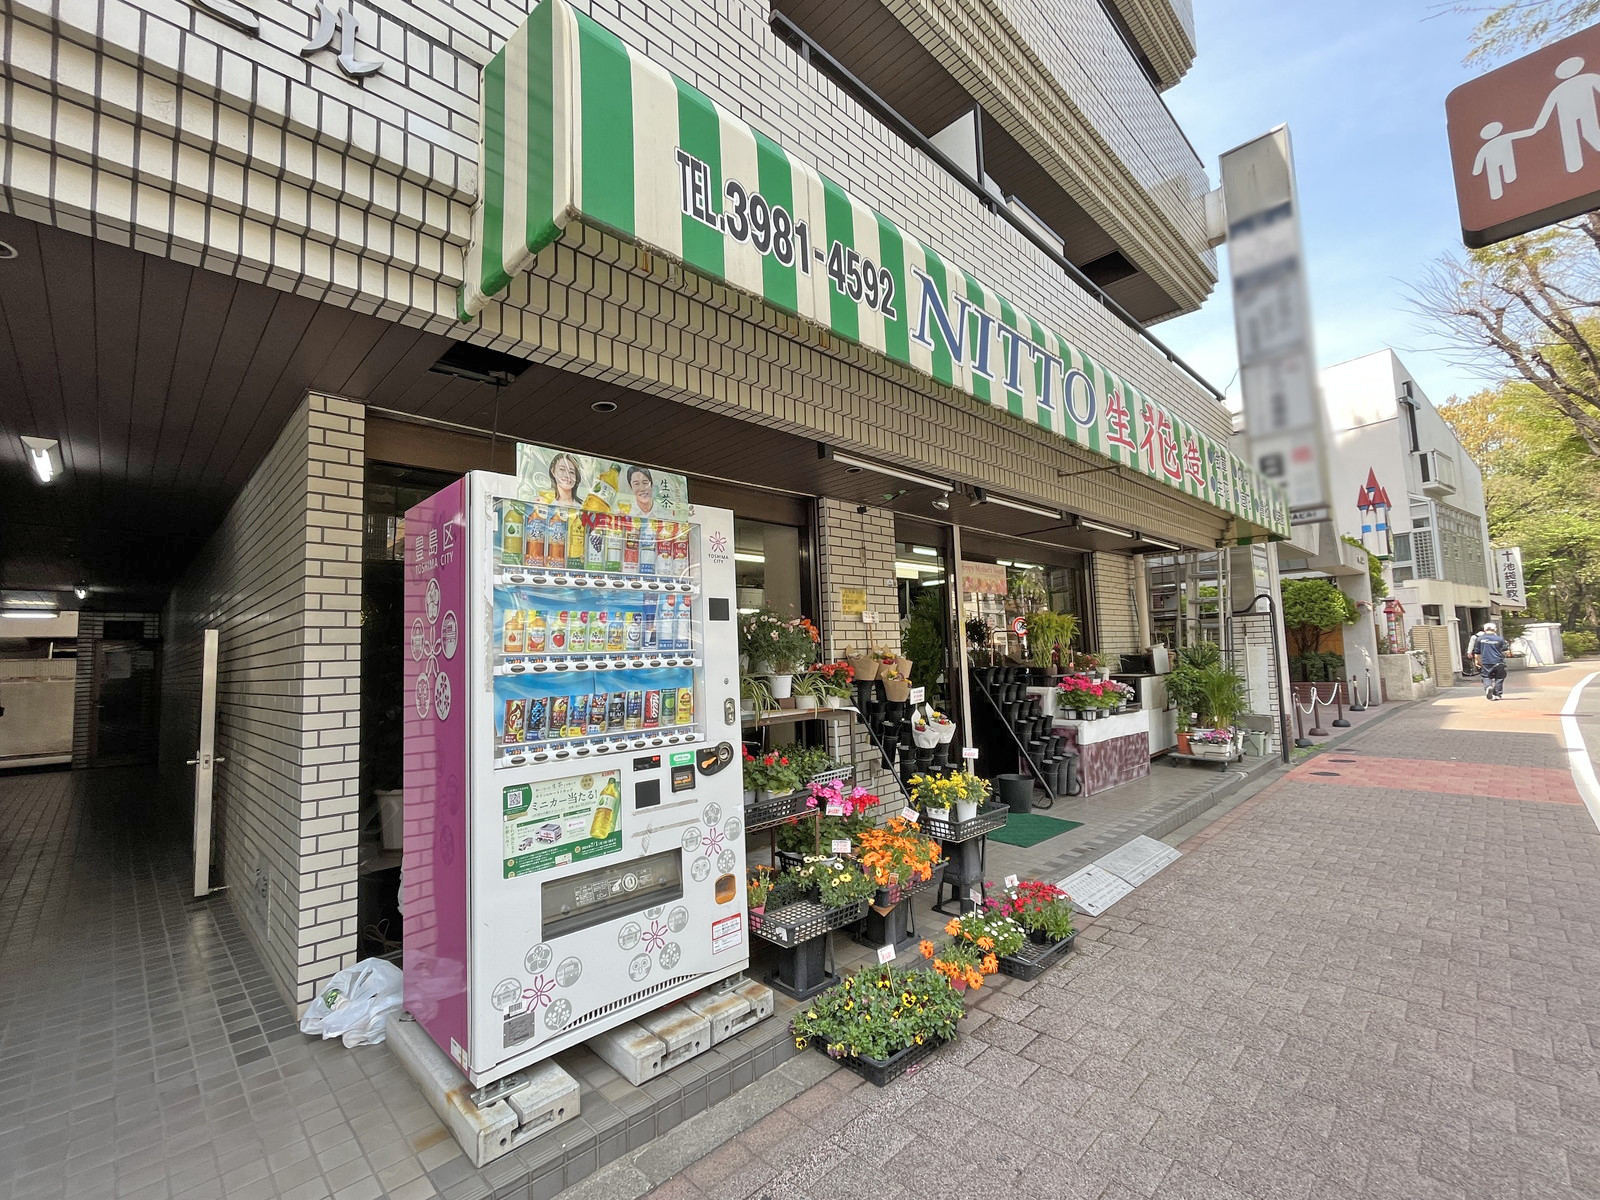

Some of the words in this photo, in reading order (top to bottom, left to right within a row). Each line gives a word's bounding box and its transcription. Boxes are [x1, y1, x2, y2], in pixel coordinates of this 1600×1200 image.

[676, 149, 897, 320] TEL.3981-4592
[911, 265, 1096, 427] NITTO
[660, 479, 673, 509] 生茶
[415, 520, 454, 562] 豊島区
[415, 558, 439, 575] TOSHIMA
[440, 551, 454, 566] CITY
[1503, 562, 1519, 602] 池袋西教
